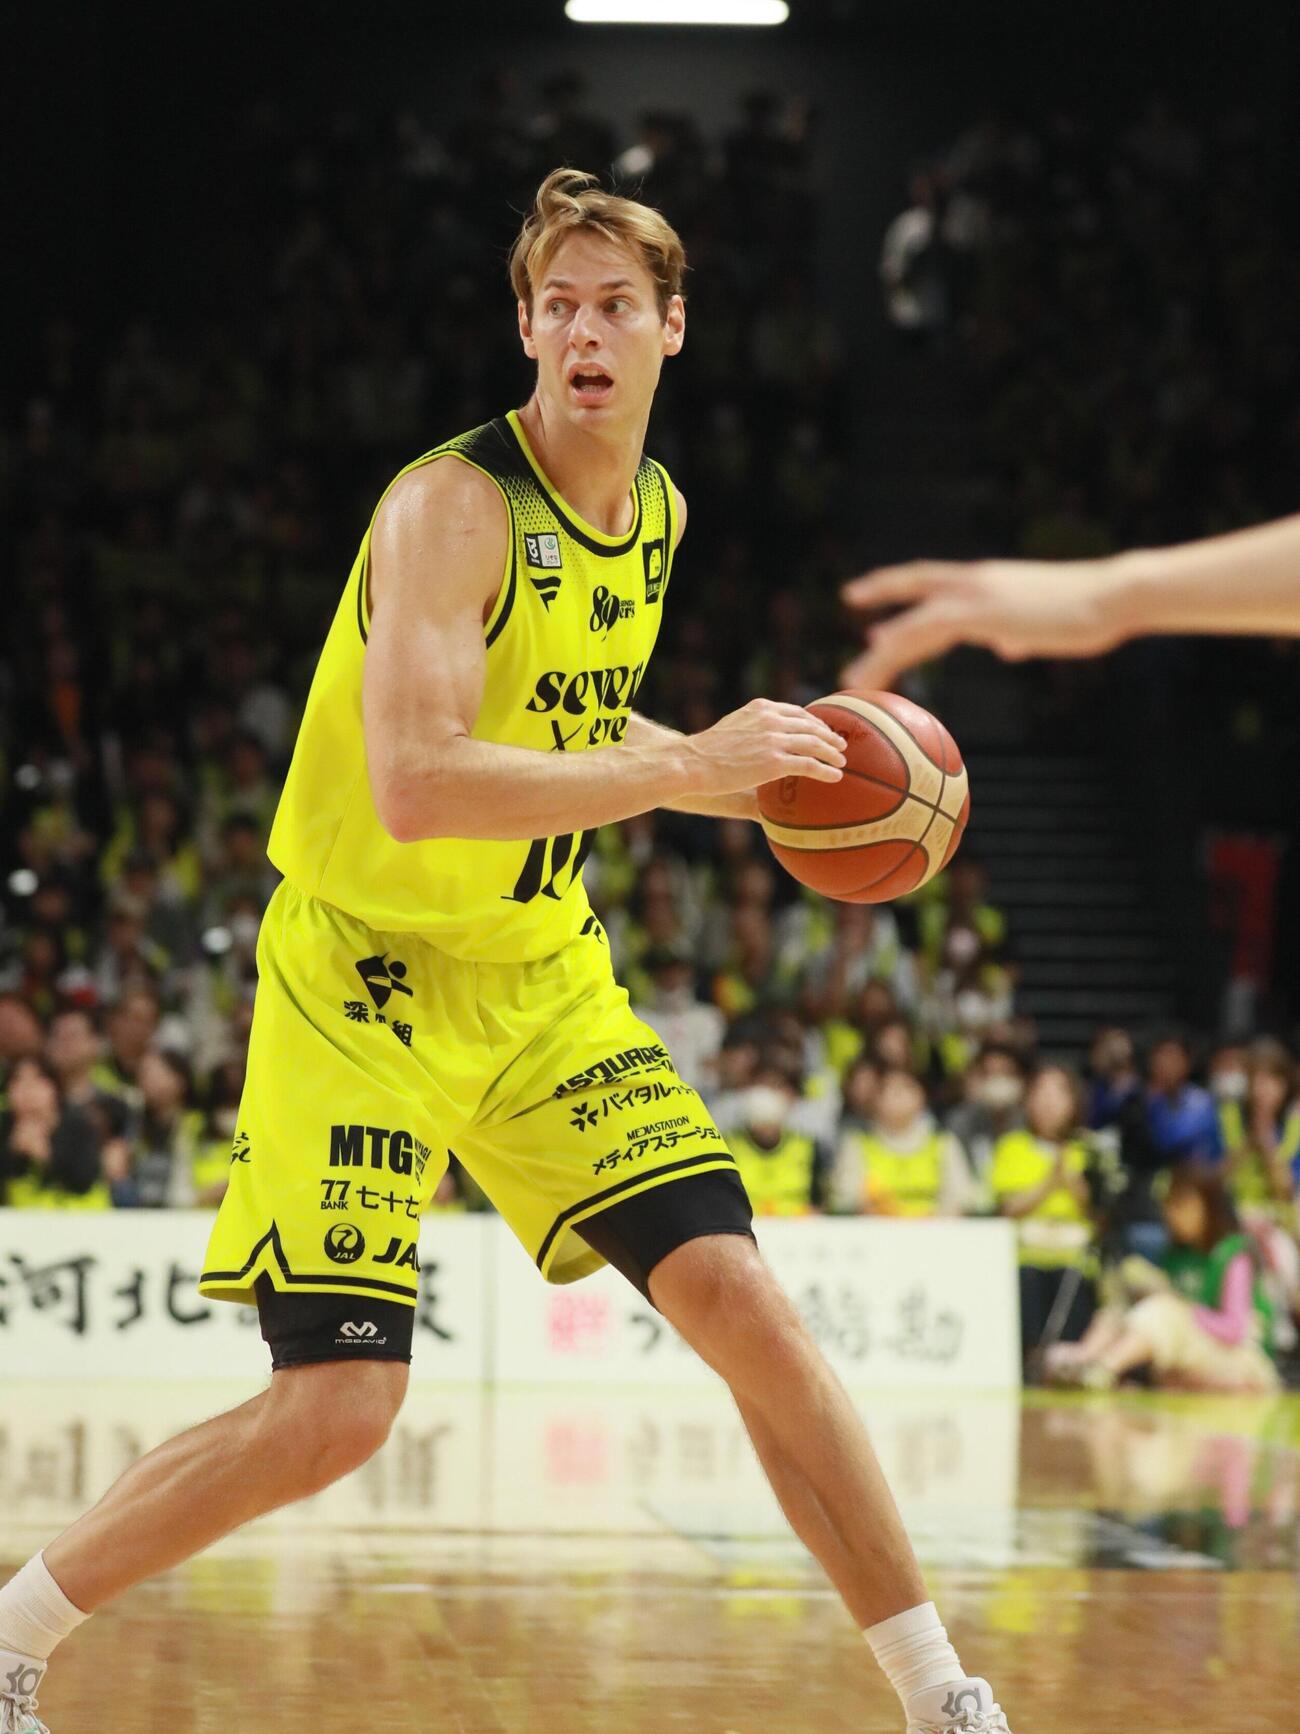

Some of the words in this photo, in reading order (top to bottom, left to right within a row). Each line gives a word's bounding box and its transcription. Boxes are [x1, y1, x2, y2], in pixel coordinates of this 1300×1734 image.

[602, 1081, 696, 1118] バイタル
[329, 1124, 413, 1175] MTG
[320, 1179, 351, 1201] 77
[356, 1185, 420, 1221] 七十七
[320, 1201, 349, 1211] BANK
[334, 1251, 356, 1260] JAL
